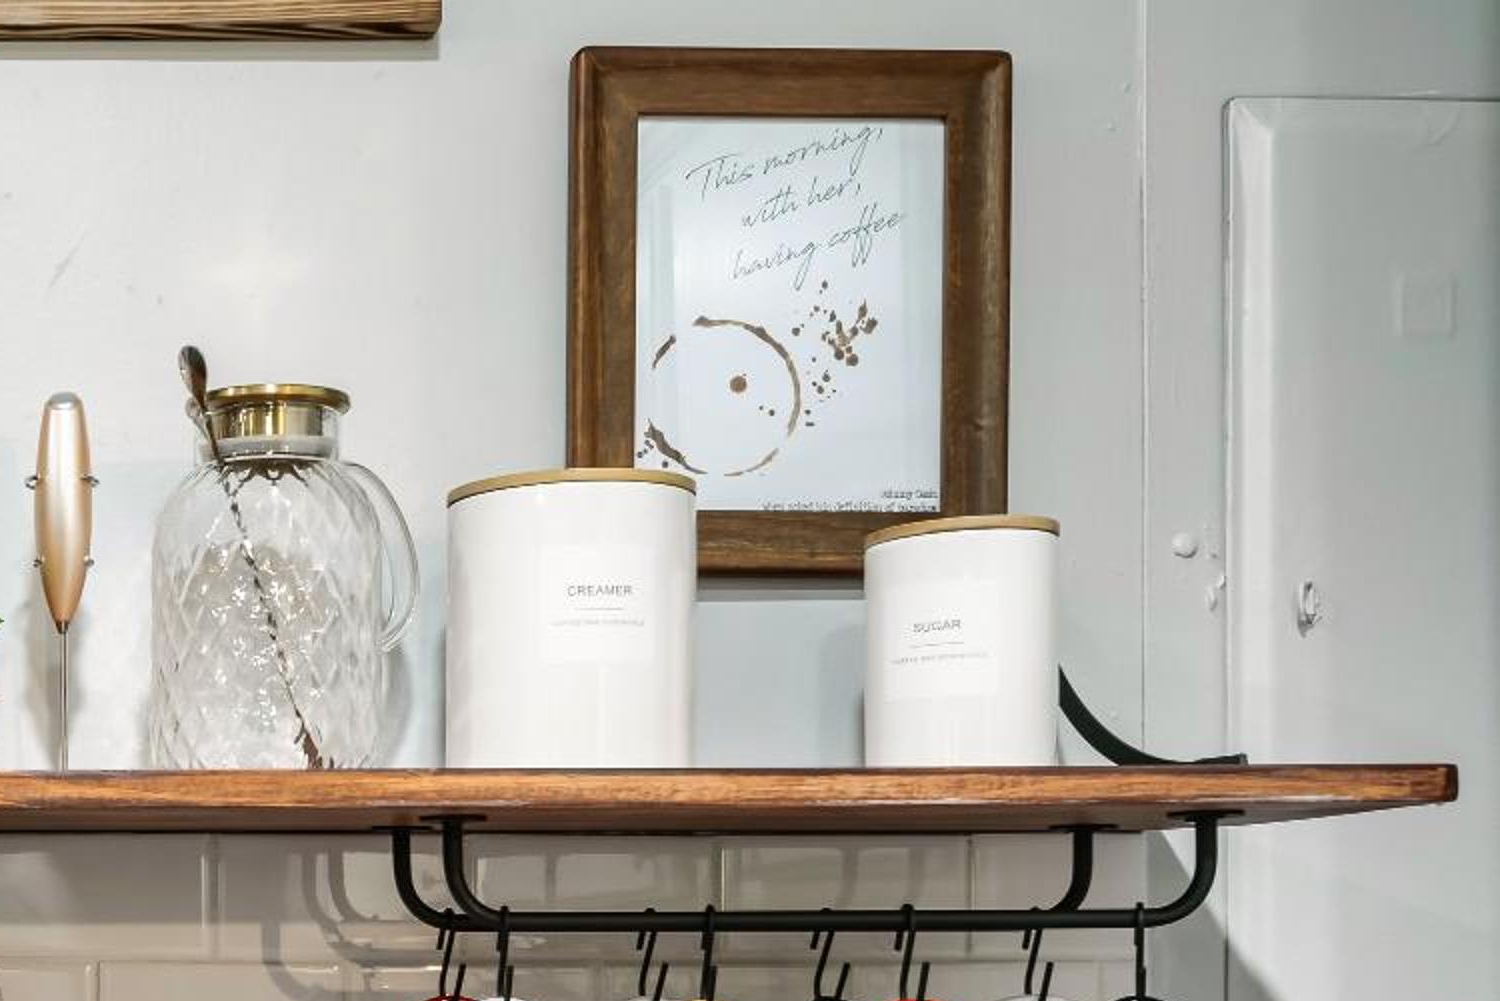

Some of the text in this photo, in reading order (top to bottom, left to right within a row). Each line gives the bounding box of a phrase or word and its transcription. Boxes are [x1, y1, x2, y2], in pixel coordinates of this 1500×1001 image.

[685, 126, 884, 202] This morning,
[742, 183, 799, 228] with
[732, 202, 905, 291] having coffee
[566, 584, 633, 597] CREAMER
[912, 618, 962, 633] SUGAR
